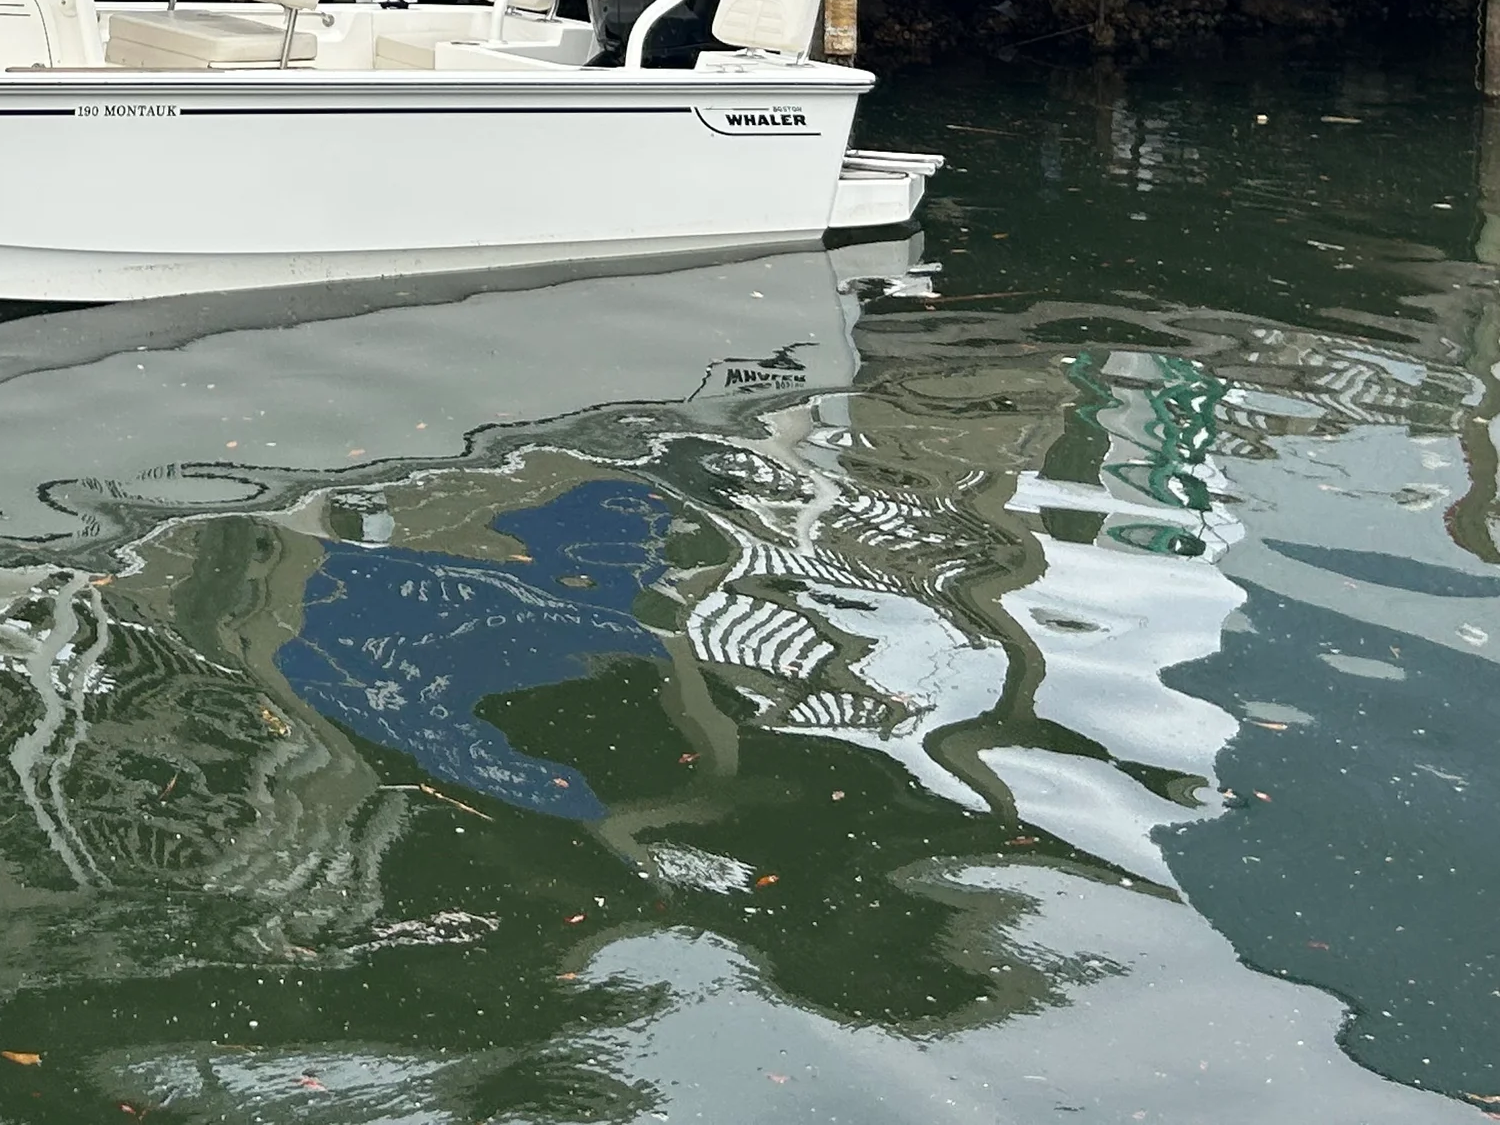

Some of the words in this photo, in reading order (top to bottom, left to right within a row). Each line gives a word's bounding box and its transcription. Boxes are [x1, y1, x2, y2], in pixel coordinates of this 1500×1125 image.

[77, 105, 99, 117] 190
[104, 105, 178, 117] MONTAUK
[724, 113, 808, 127] WHALER
